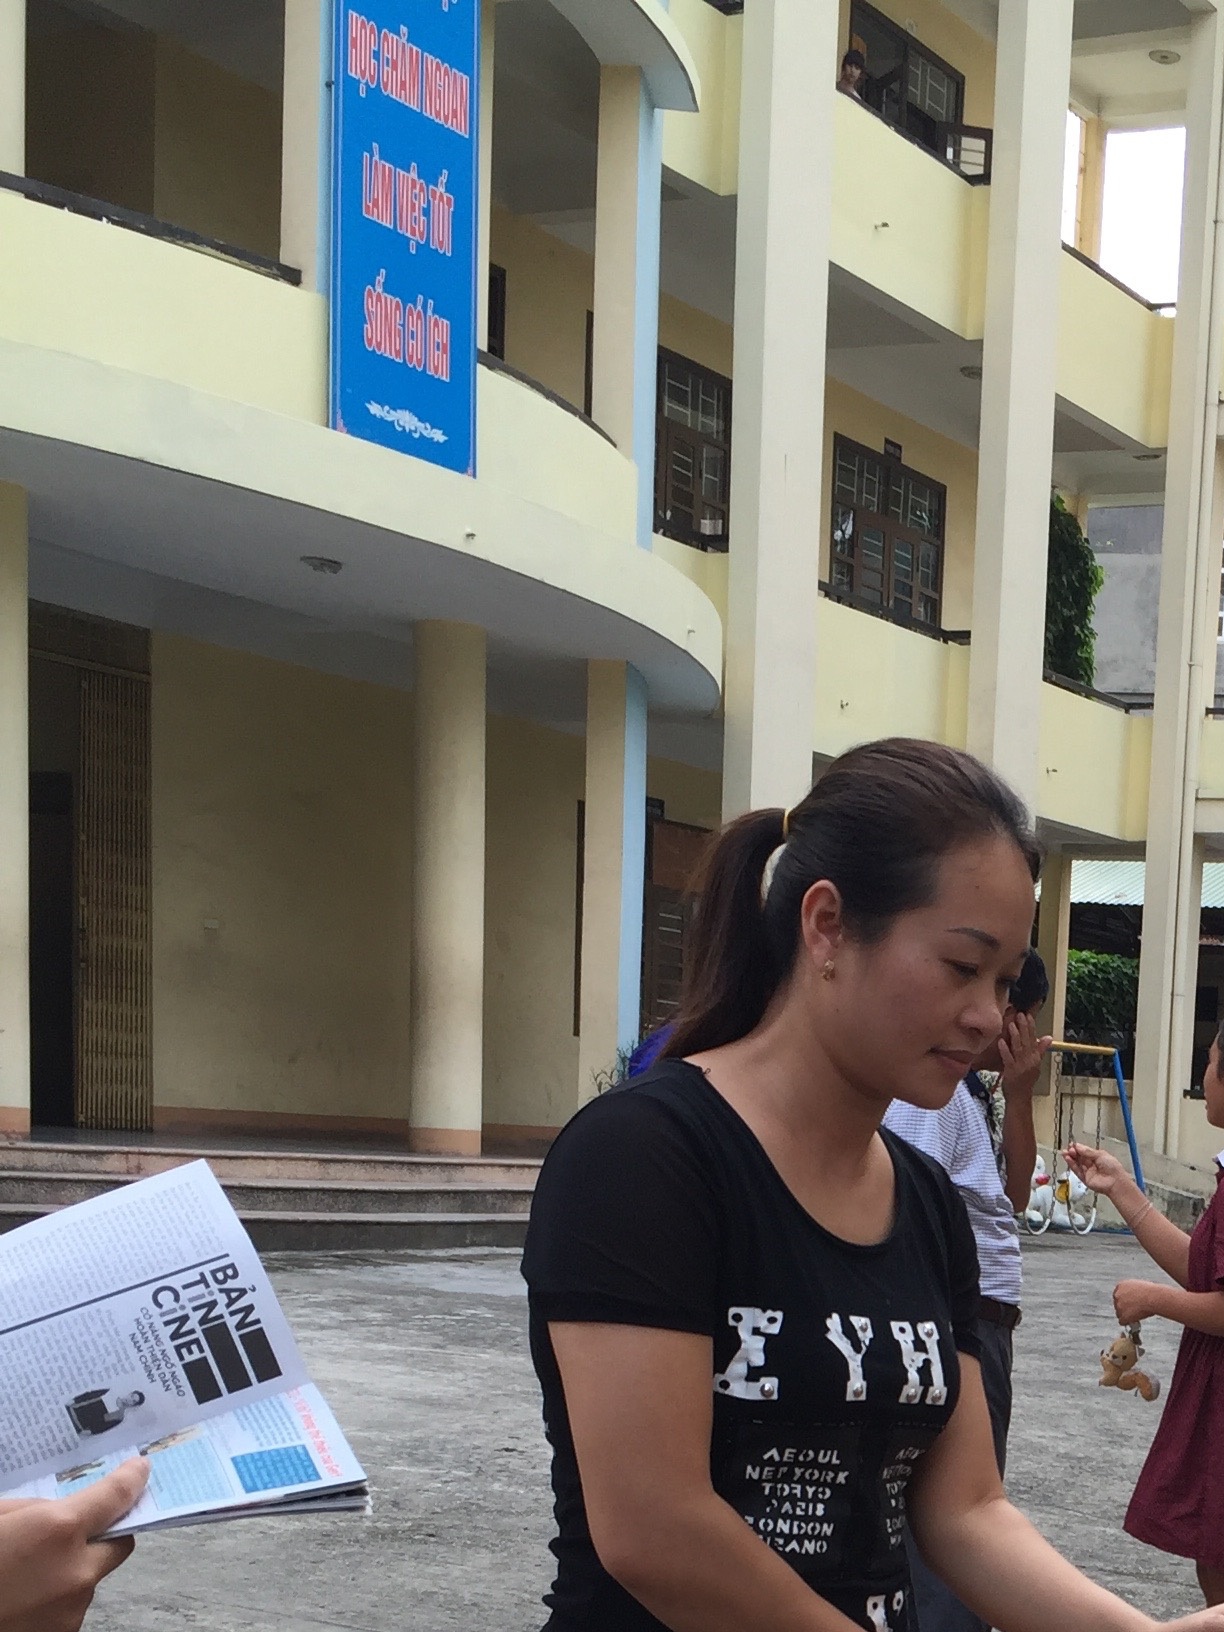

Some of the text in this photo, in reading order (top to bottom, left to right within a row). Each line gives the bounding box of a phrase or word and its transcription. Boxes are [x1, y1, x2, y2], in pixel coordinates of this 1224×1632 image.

[348, 9, 470, 138] HỌC CHĂM NGOAN
[363, 142, 454, 256] LÀM VIỆC TỐT
[363, 268, 450, 382] SỐNG CÓ ÍCH
[209, 1262, 262, 1332] BẢN
